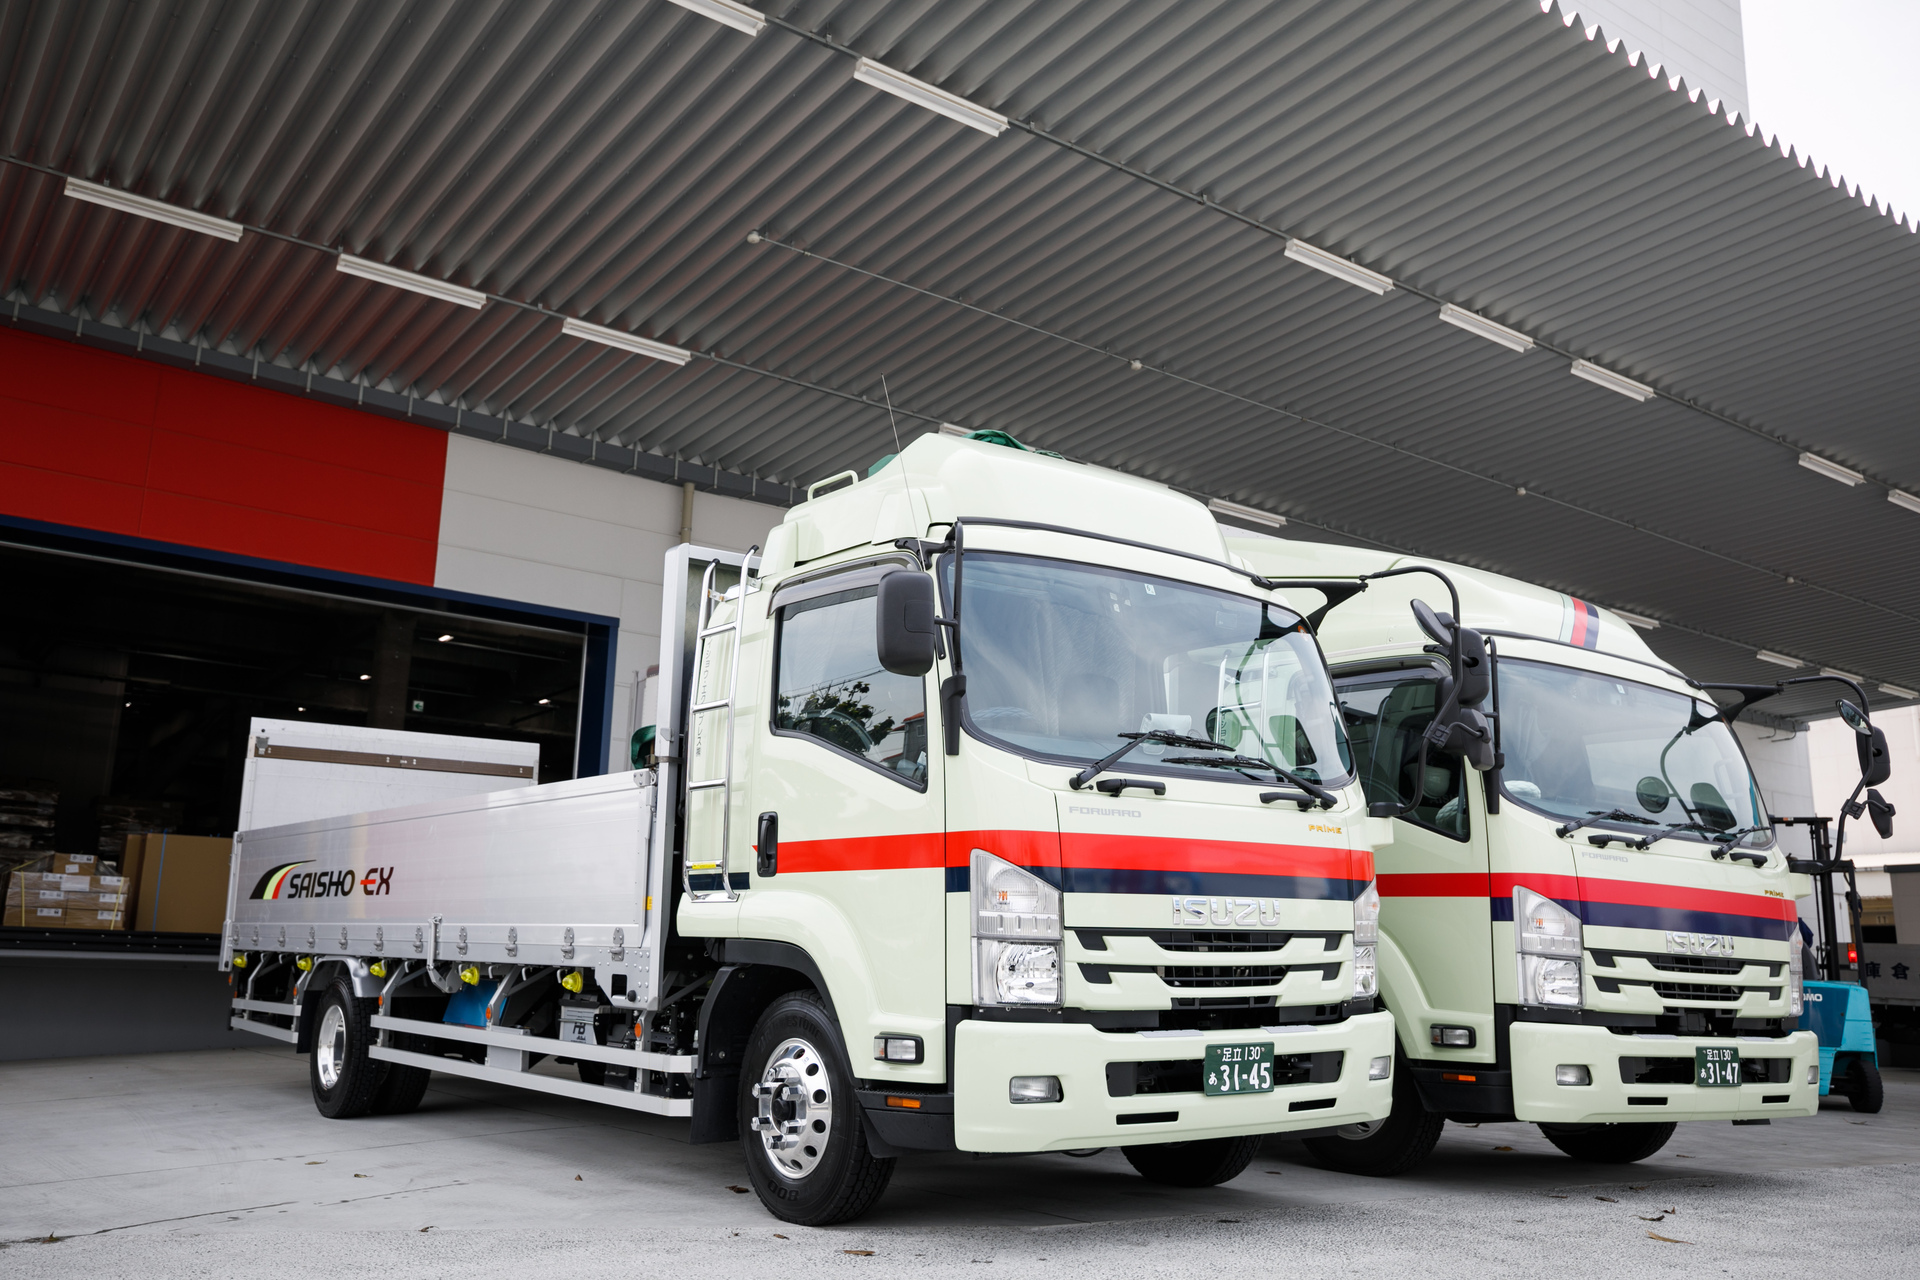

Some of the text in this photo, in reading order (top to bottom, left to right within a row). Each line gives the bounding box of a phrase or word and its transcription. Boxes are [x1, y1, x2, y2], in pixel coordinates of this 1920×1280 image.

[1068, 805, 1142, 818] FORWARD
[1581, 851, 1629, 863] FORWARD
[287, 866, 394, 899] SAISHO EX
[1172, 896, 1281, 927] ISUZU
[1665, 930, 1735, 957] ISUZU
[1221, 1046, 1261, 1062] 足立 130
[1706, 1048, 1732, 1061] 足立 130
[1208, 1062, 1271, 1092] あ 31-45
[1706, 1062, 1739, 1084] 31-47
